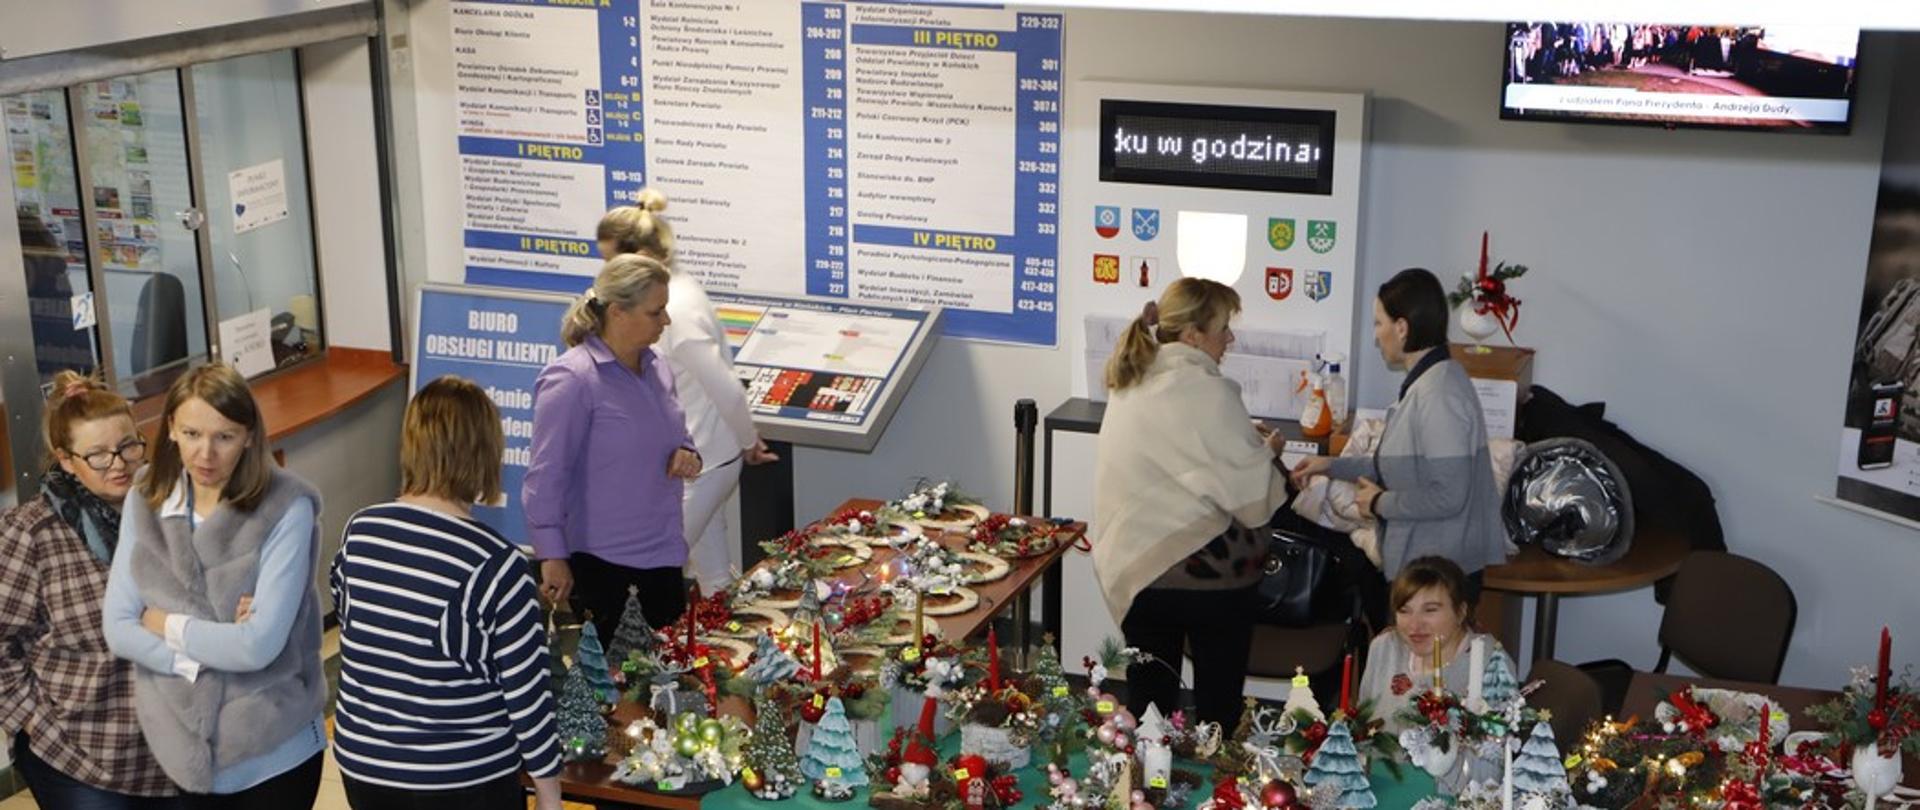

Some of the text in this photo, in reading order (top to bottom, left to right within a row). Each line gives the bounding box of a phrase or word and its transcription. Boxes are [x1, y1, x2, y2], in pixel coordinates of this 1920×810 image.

[914, 30, 999, 48] III PIĘTRO
[1712, 102, 1760, 114] Andrzeja
[1115, 127, 1148, 154] ku
[1157, 135, 1183, 156] w
[528, 146, 583, 160] PIĘTRO
[1038, 182, 1056, 194] 332
[1038, 202, 1056, 214] 332
[1038, 222, 1056, 235] 333
[520, 236, 589, 255] II PIĘTRO
[913, 232, 997, 250] IV PIĘTRO
[468, 310, 518, 334] BIURO
[426, 334, 558, 365] OBSŁUGI KLIENTA
[487, 386, 532, 410] danie
